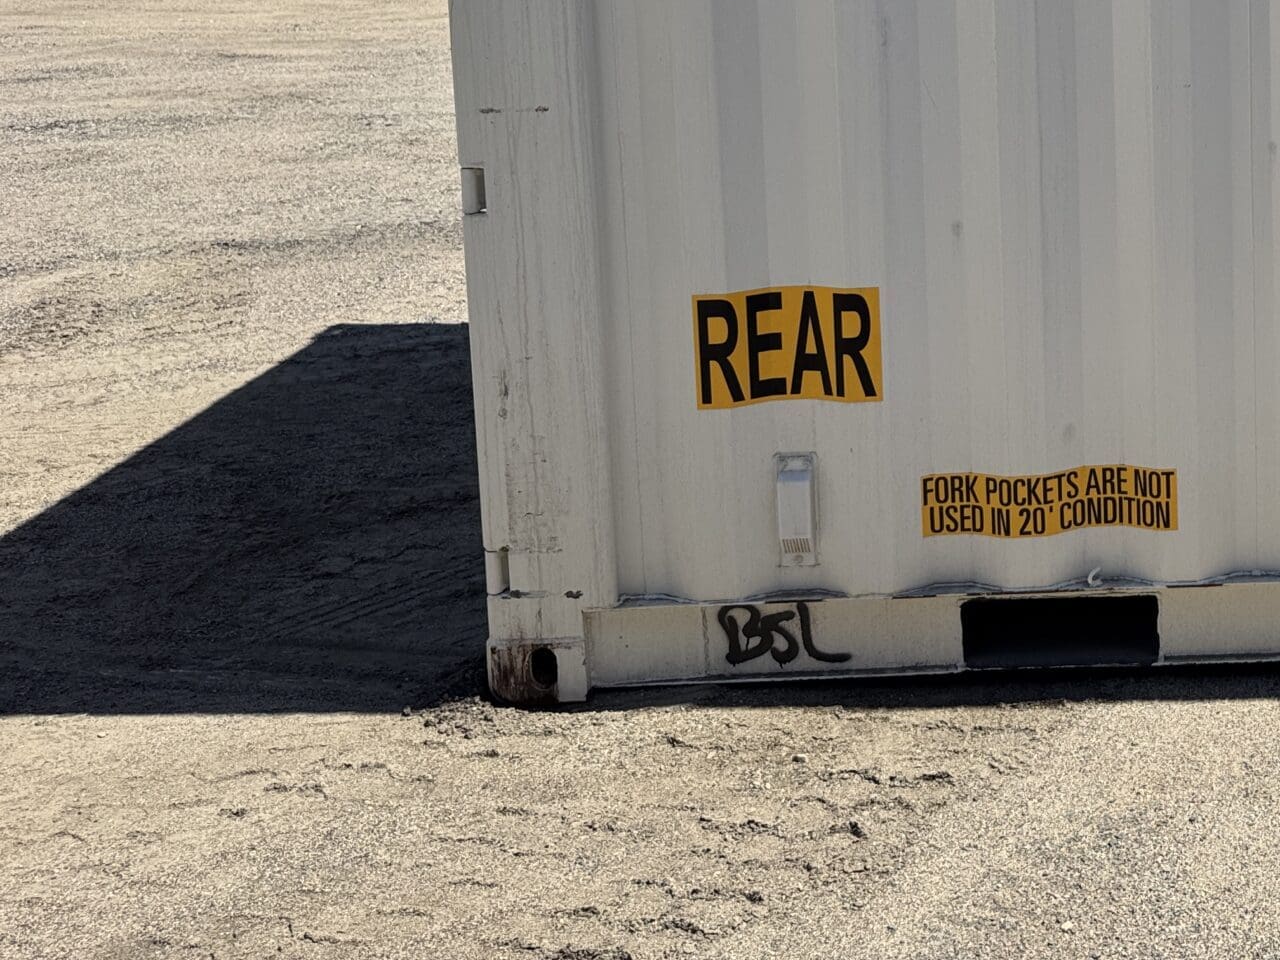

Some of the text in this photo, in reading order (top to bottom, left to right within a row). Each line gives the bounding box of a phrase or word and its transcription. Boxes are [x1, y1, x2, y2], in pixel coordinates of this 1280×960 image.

[696, 290, 877, 405] REAR
[922, 467, 1174, 507] FORK POCKETS ARE NOT
[929, 497, 1171, 536] USED IN 20' CONDITION
[717, 603, 853, 669] BSL
